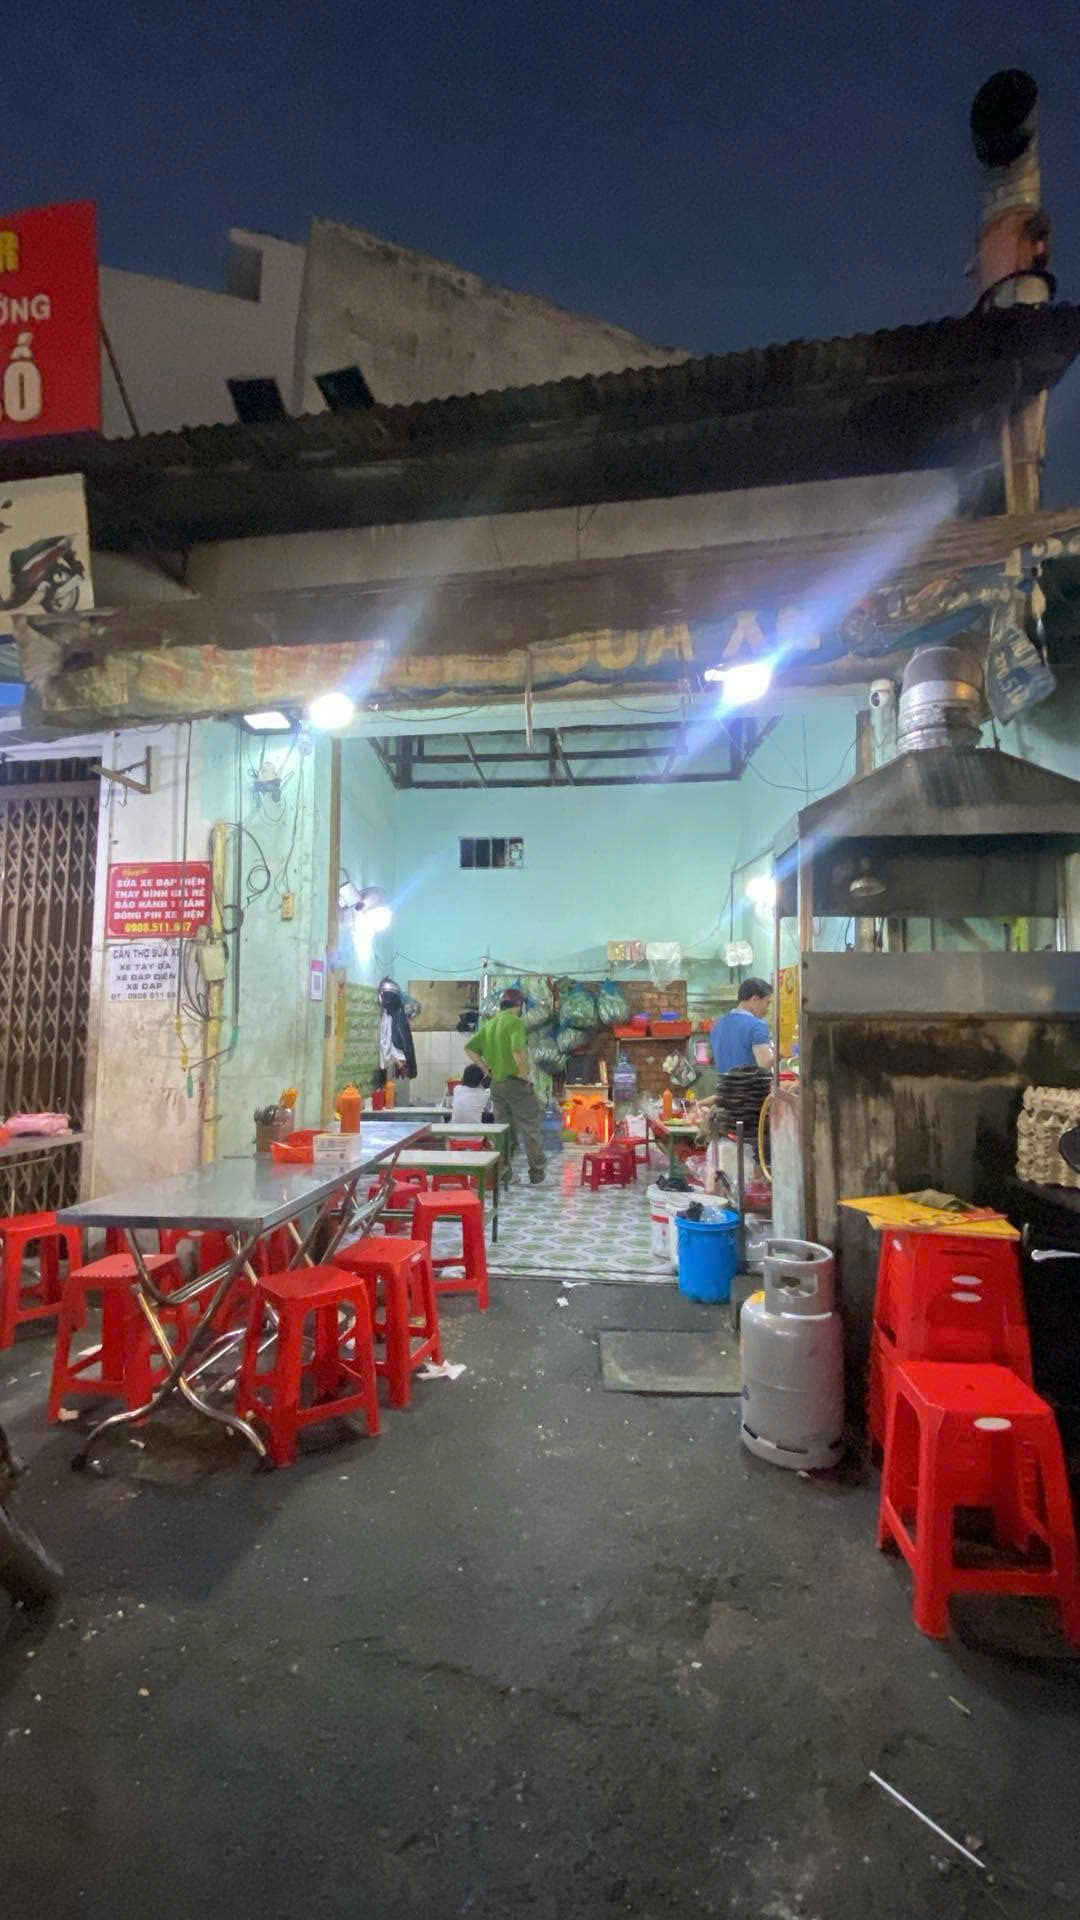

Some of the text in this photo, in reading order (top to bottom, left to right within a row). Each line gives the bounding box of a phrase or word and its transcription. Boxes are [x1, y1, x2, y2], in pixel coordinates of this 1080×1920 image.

[0, 331, 42, 422] Ố
[140, 878, 153, 887] XE
[114, 890, 140, 899] THAY
[144, 911, 162, 919] PIN
[165, 910, 177, 919] XE
[180, 909, 205, 920] IỆN
[119, 963, 131, 971] XE
